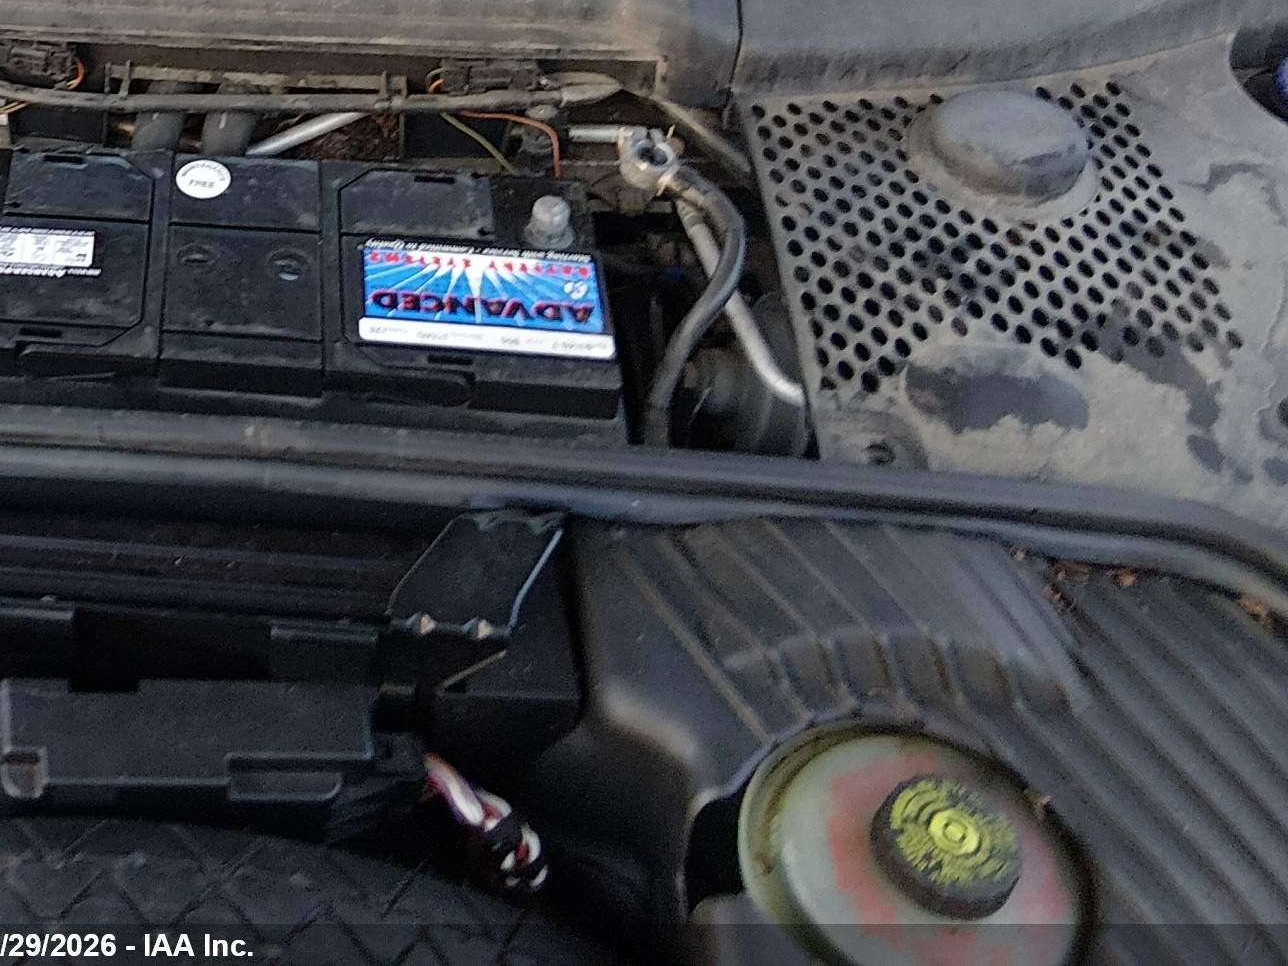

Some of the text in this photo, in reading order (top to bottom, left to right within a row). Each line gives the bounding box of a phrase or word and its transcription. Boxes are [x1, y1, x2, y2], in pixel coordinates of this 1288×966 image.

[188, 179, 216, 188] FREE
[369, 251, 590, 277] BATTERY SYSTEMS
[370, 289, 595, 323] ADVANCED
